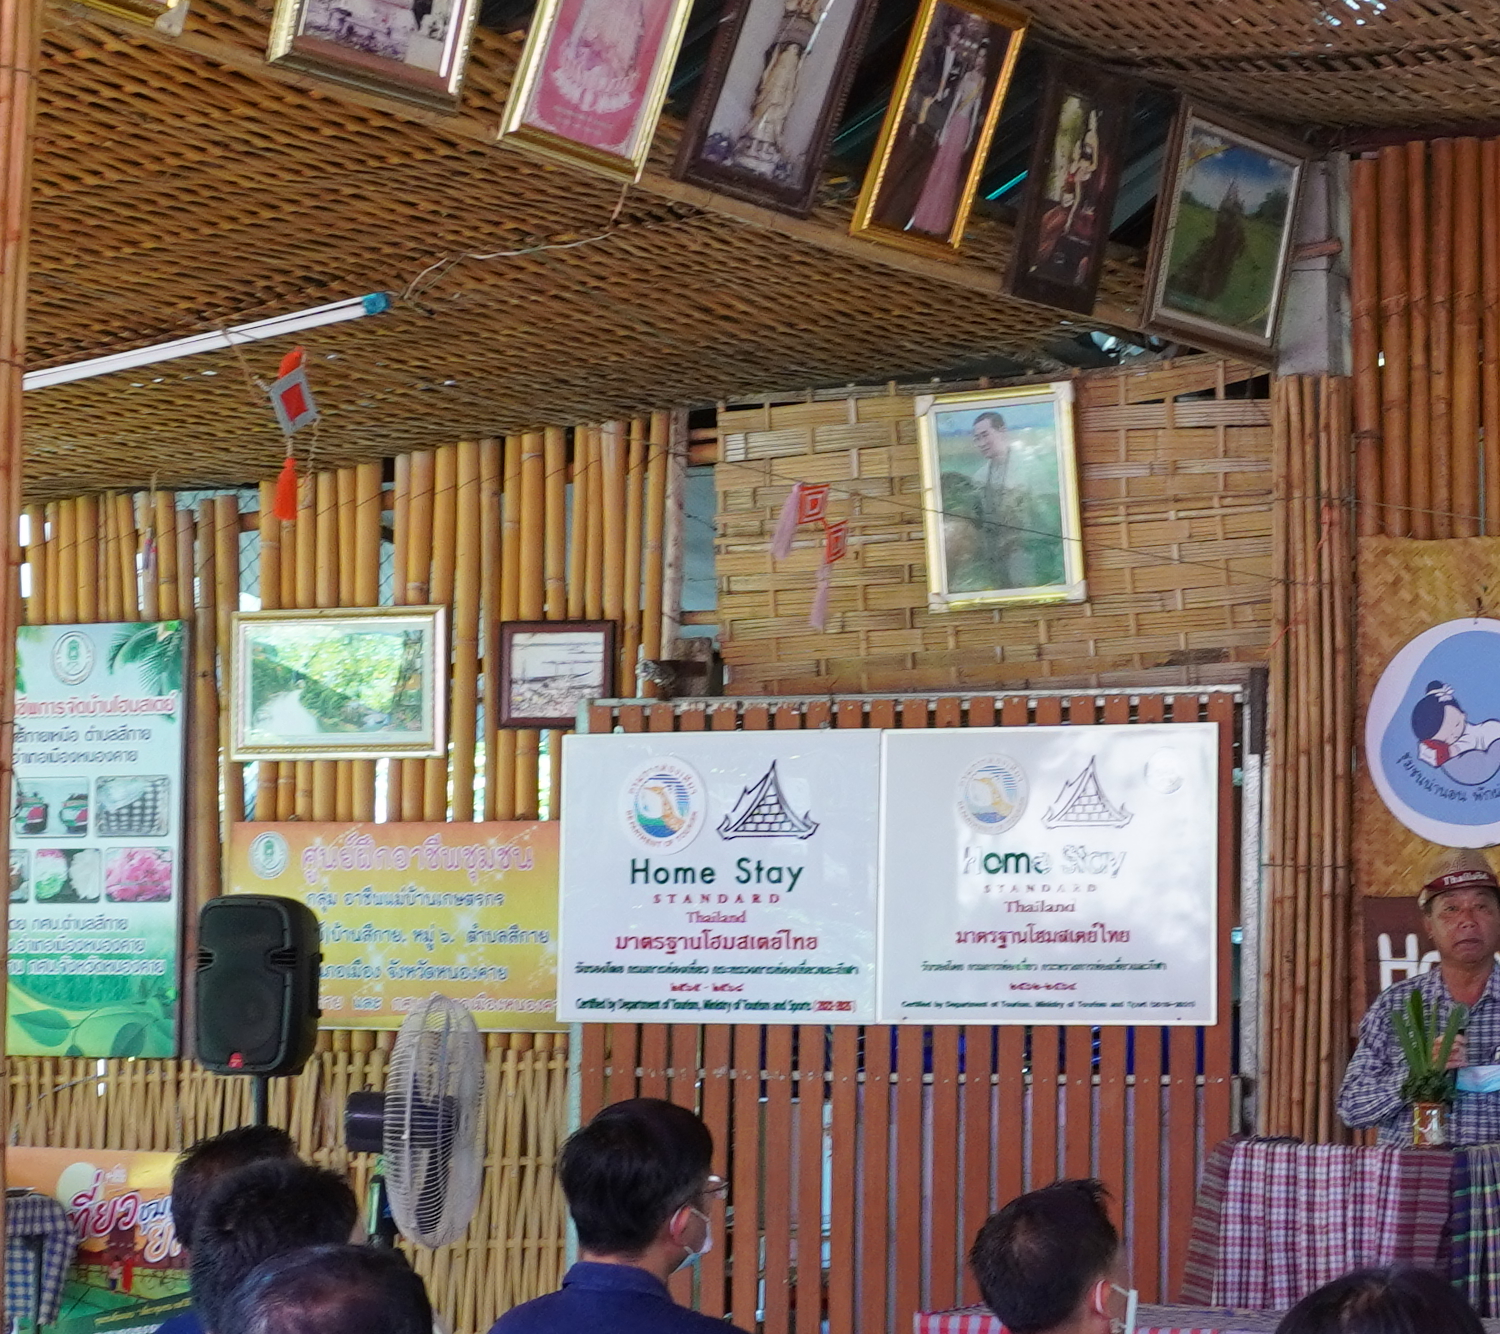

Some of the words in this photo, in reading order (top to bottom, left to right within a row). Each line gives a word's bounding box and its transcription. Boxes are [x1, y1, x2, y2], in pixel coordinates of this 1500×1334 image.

[631, 857, 717, 885] Home
[735, 857, 804, 892] Stay
[983, 883, 1098, 893] STANDARD
[653, 893, 781, 904] STANDARD
[1004, 900, 1076, 913] Thailand
[686, 911, 747, 923] Thailand
[955, 922, 1131, 949] มาตรฐานโฮมสเตย์ไทย
[615, 930, 818, 955] มาตรฐานโฮมสเตย์ไทย
